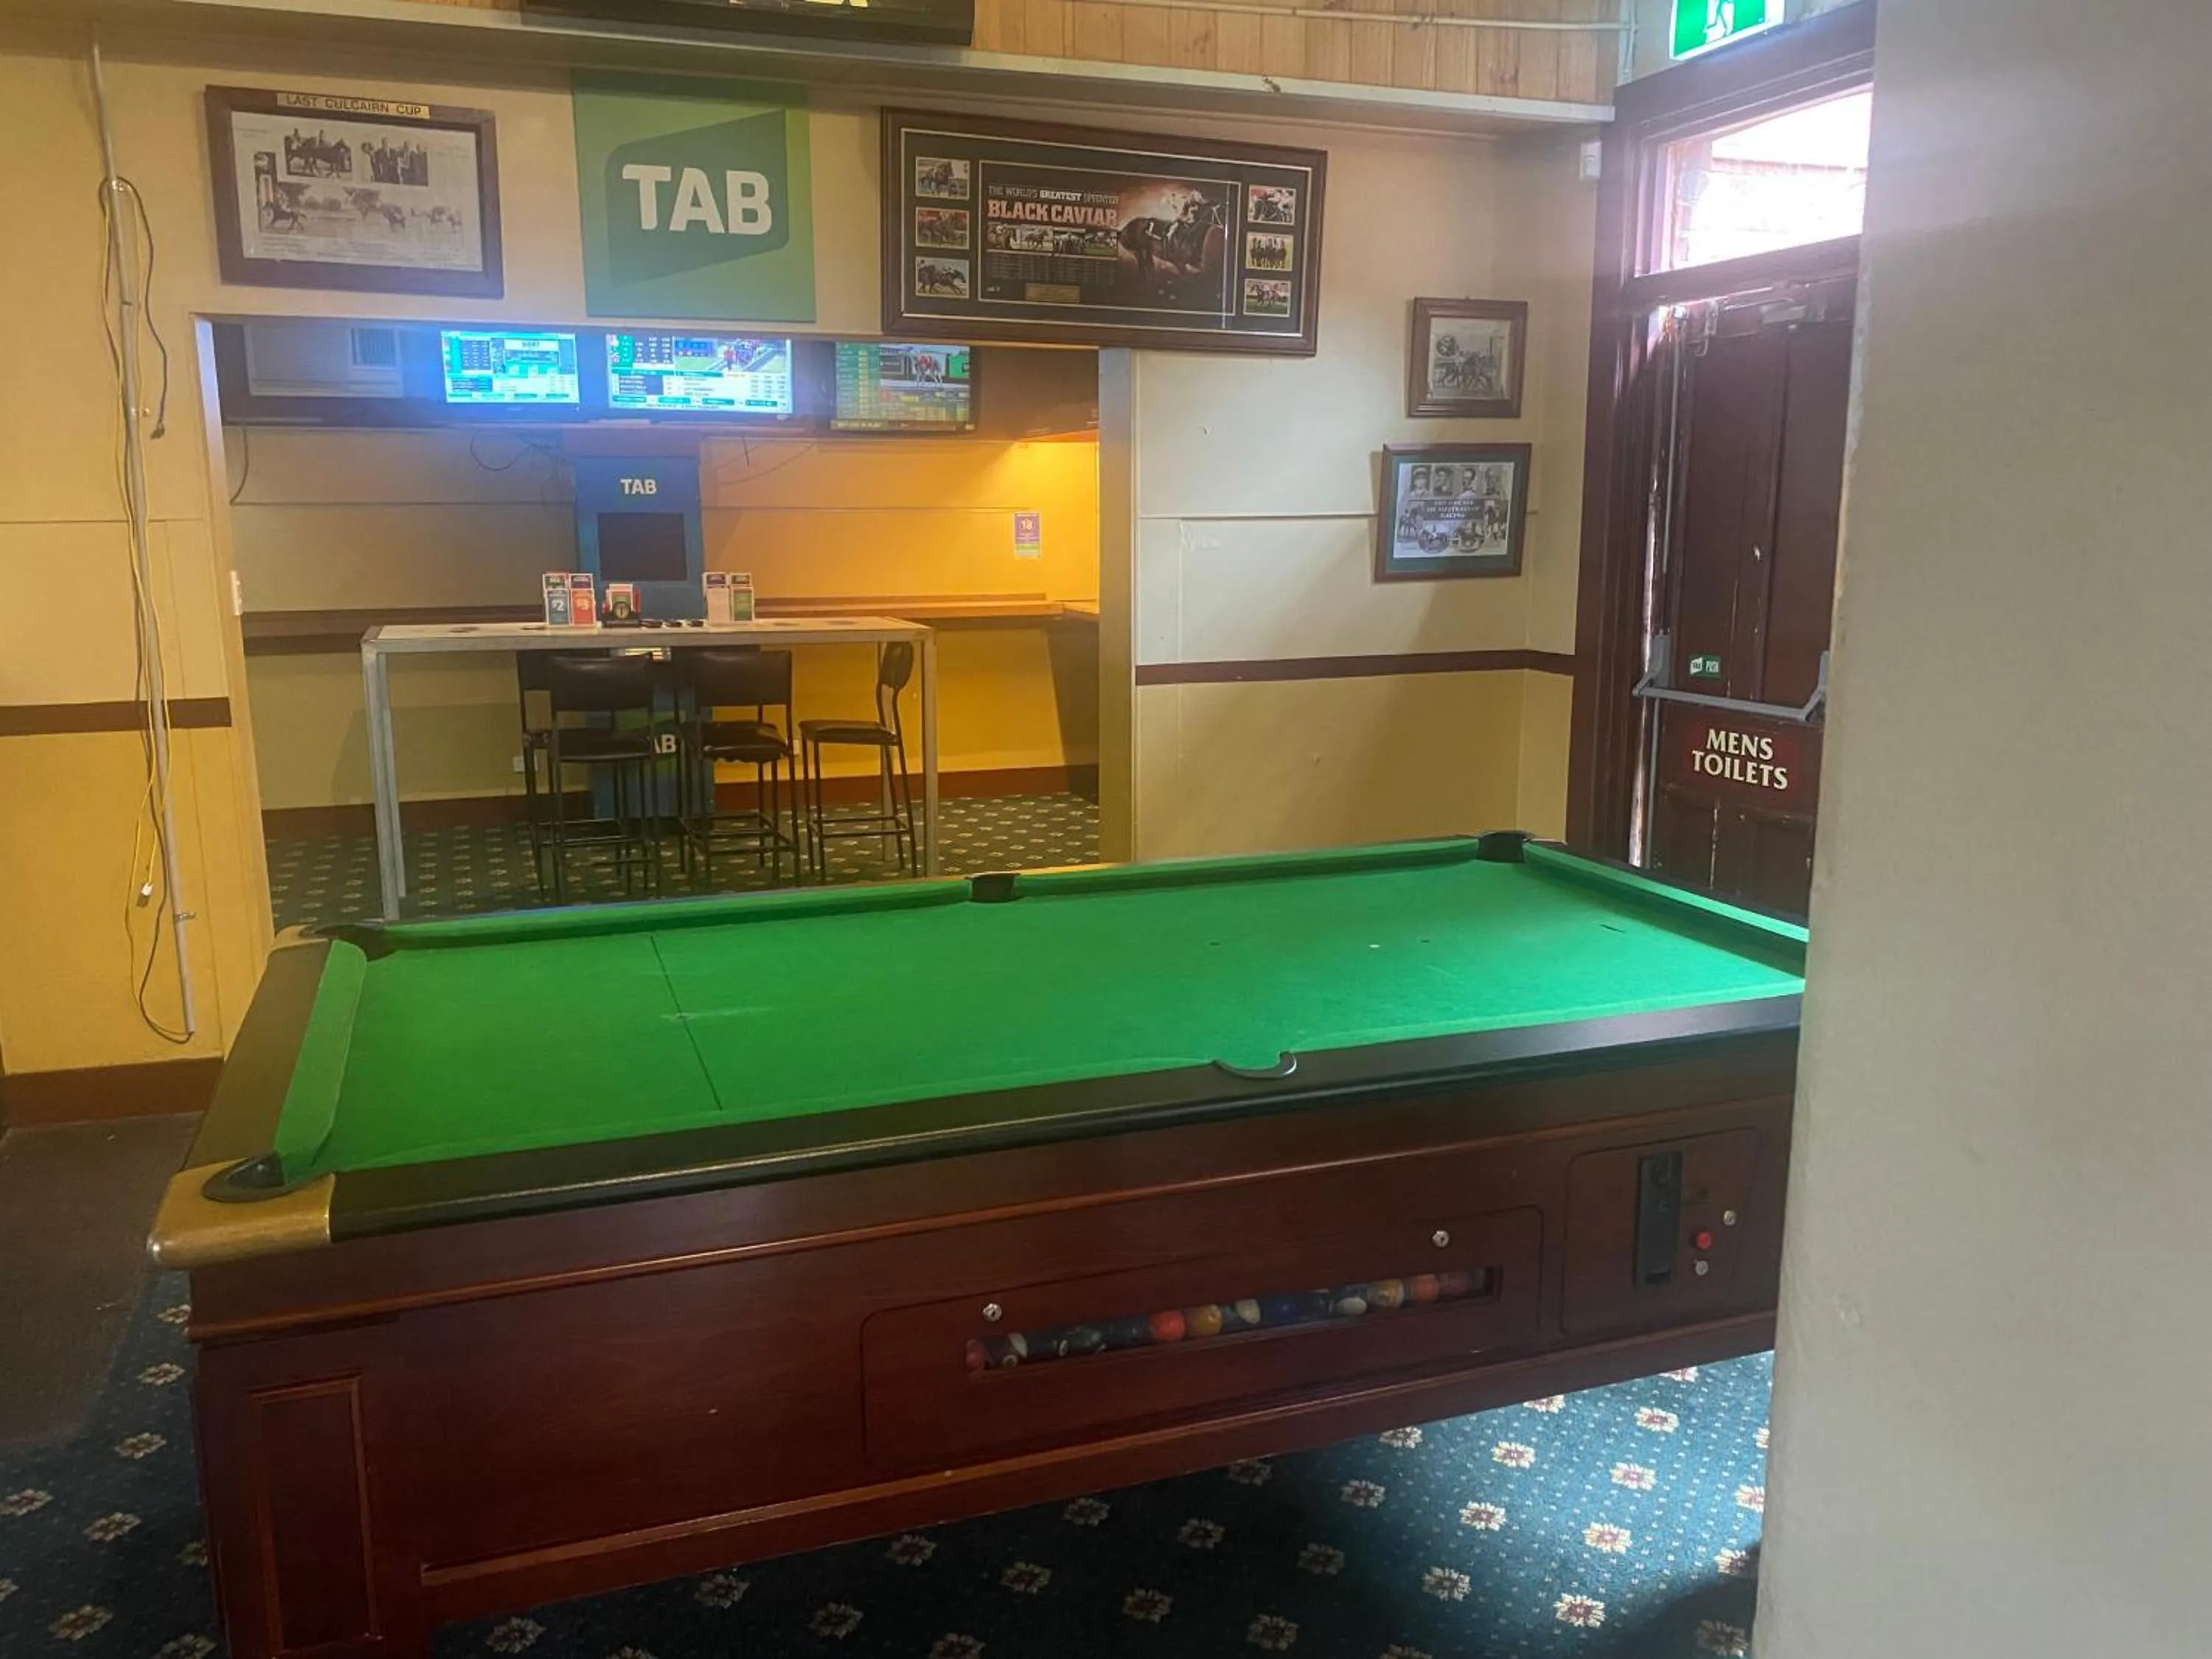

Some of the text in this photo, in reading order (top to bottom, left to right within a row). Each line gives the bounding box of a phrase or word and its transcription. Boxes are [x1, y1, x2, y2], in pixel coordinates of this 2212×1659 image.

[286, 94, 422, 116] LAST CULCAIRN CUP
[622, 164, 773, 236] TAB
[1039, 189, 1082, 201] GREATEST
[987, 199, 1118, 227] BLACK CAVIAR
[620, 479, 657, 495] TAB
[1706, 728, 1773, 761] MENS
[1691, 750, 1789, 790] TOILETS
